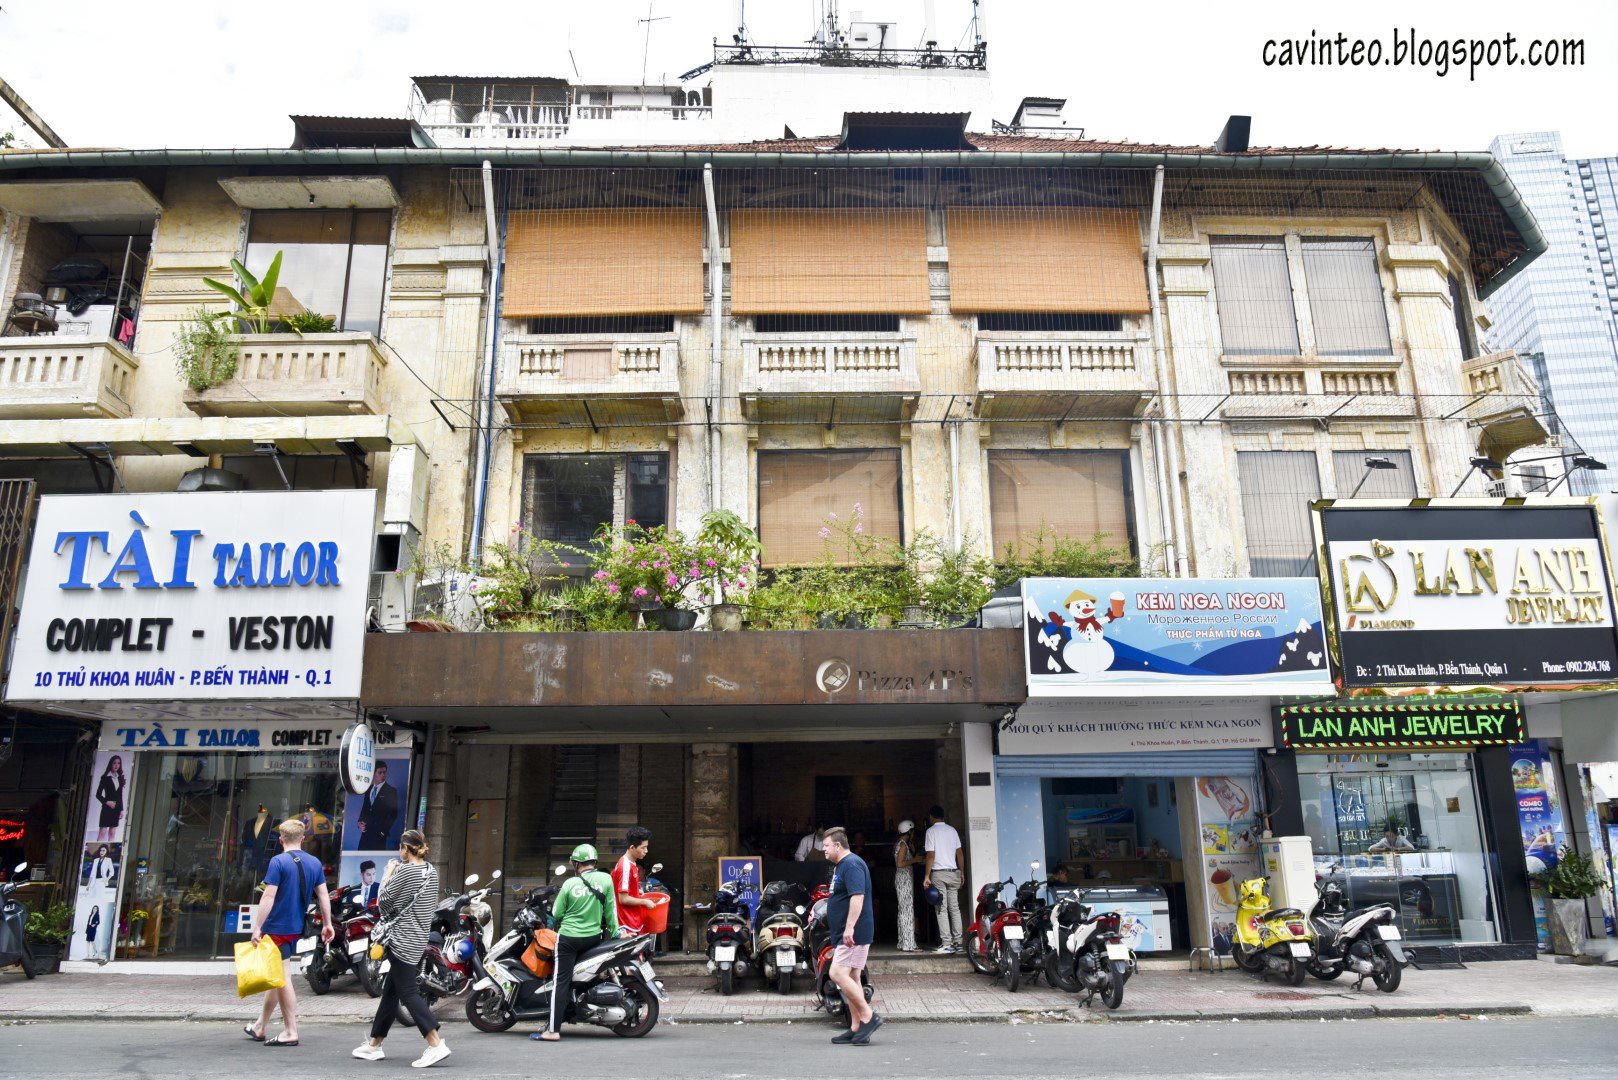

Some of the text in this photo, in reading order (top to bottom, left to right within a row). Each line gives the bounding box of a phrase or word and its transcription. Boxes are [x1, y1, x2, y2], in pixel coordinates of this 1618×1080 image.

[53, 510, 341, 591] TÀI TAILOR
[1409, 547, 1600, 596] LAN ANH
[1136, 592, 1286, 611] KEM NGA NGON
[1506, 597, 1604, 624] JEWELRY
[1148, 613, 1278, 625] Мороженное России
[1360, 619, 1415, 629] DIAMOND
[46, 618, 173, 652] COMPLET
[229, 615, 334, 650] VESTON
[1240, 629, 1262, 638] NGA
[35, 672, 52, 687] 10
[57, 665, 87, 687] THỦ
[89, 671, 130, 686] KHOA
[134, 667, 175, 686] HUÂN
[238, 666, 289, 685] THÀNH
[1376, 665, 1381, 677] 2
[1396, 664, 1417, 676] Khoa
[1483, 662, 1503, 677] Quận
[1503, 662, 1508, 674] 1
[1542, 661, 1566, 673] Phone:
[1565, 660, 1611, 672] 0902.284.768
[857, 670, 973, 691] Pizza 4P's
[116, 722, 190, 747] TÀI
[197, 728, 260, 747] TAILOR
[271, 729, 332, 747] COMPLET
[1058, 721, 1096, 733] KHÁCH
[1180, 720, 1203, 730] KEM
[1206, 720, 1229, 729] NGA
[1231, 719, 1261, 728] NGON
[1298, 714, 1505, 738] LAN ANH JEWELRY
[357, 733, 373, 757] TÀI
